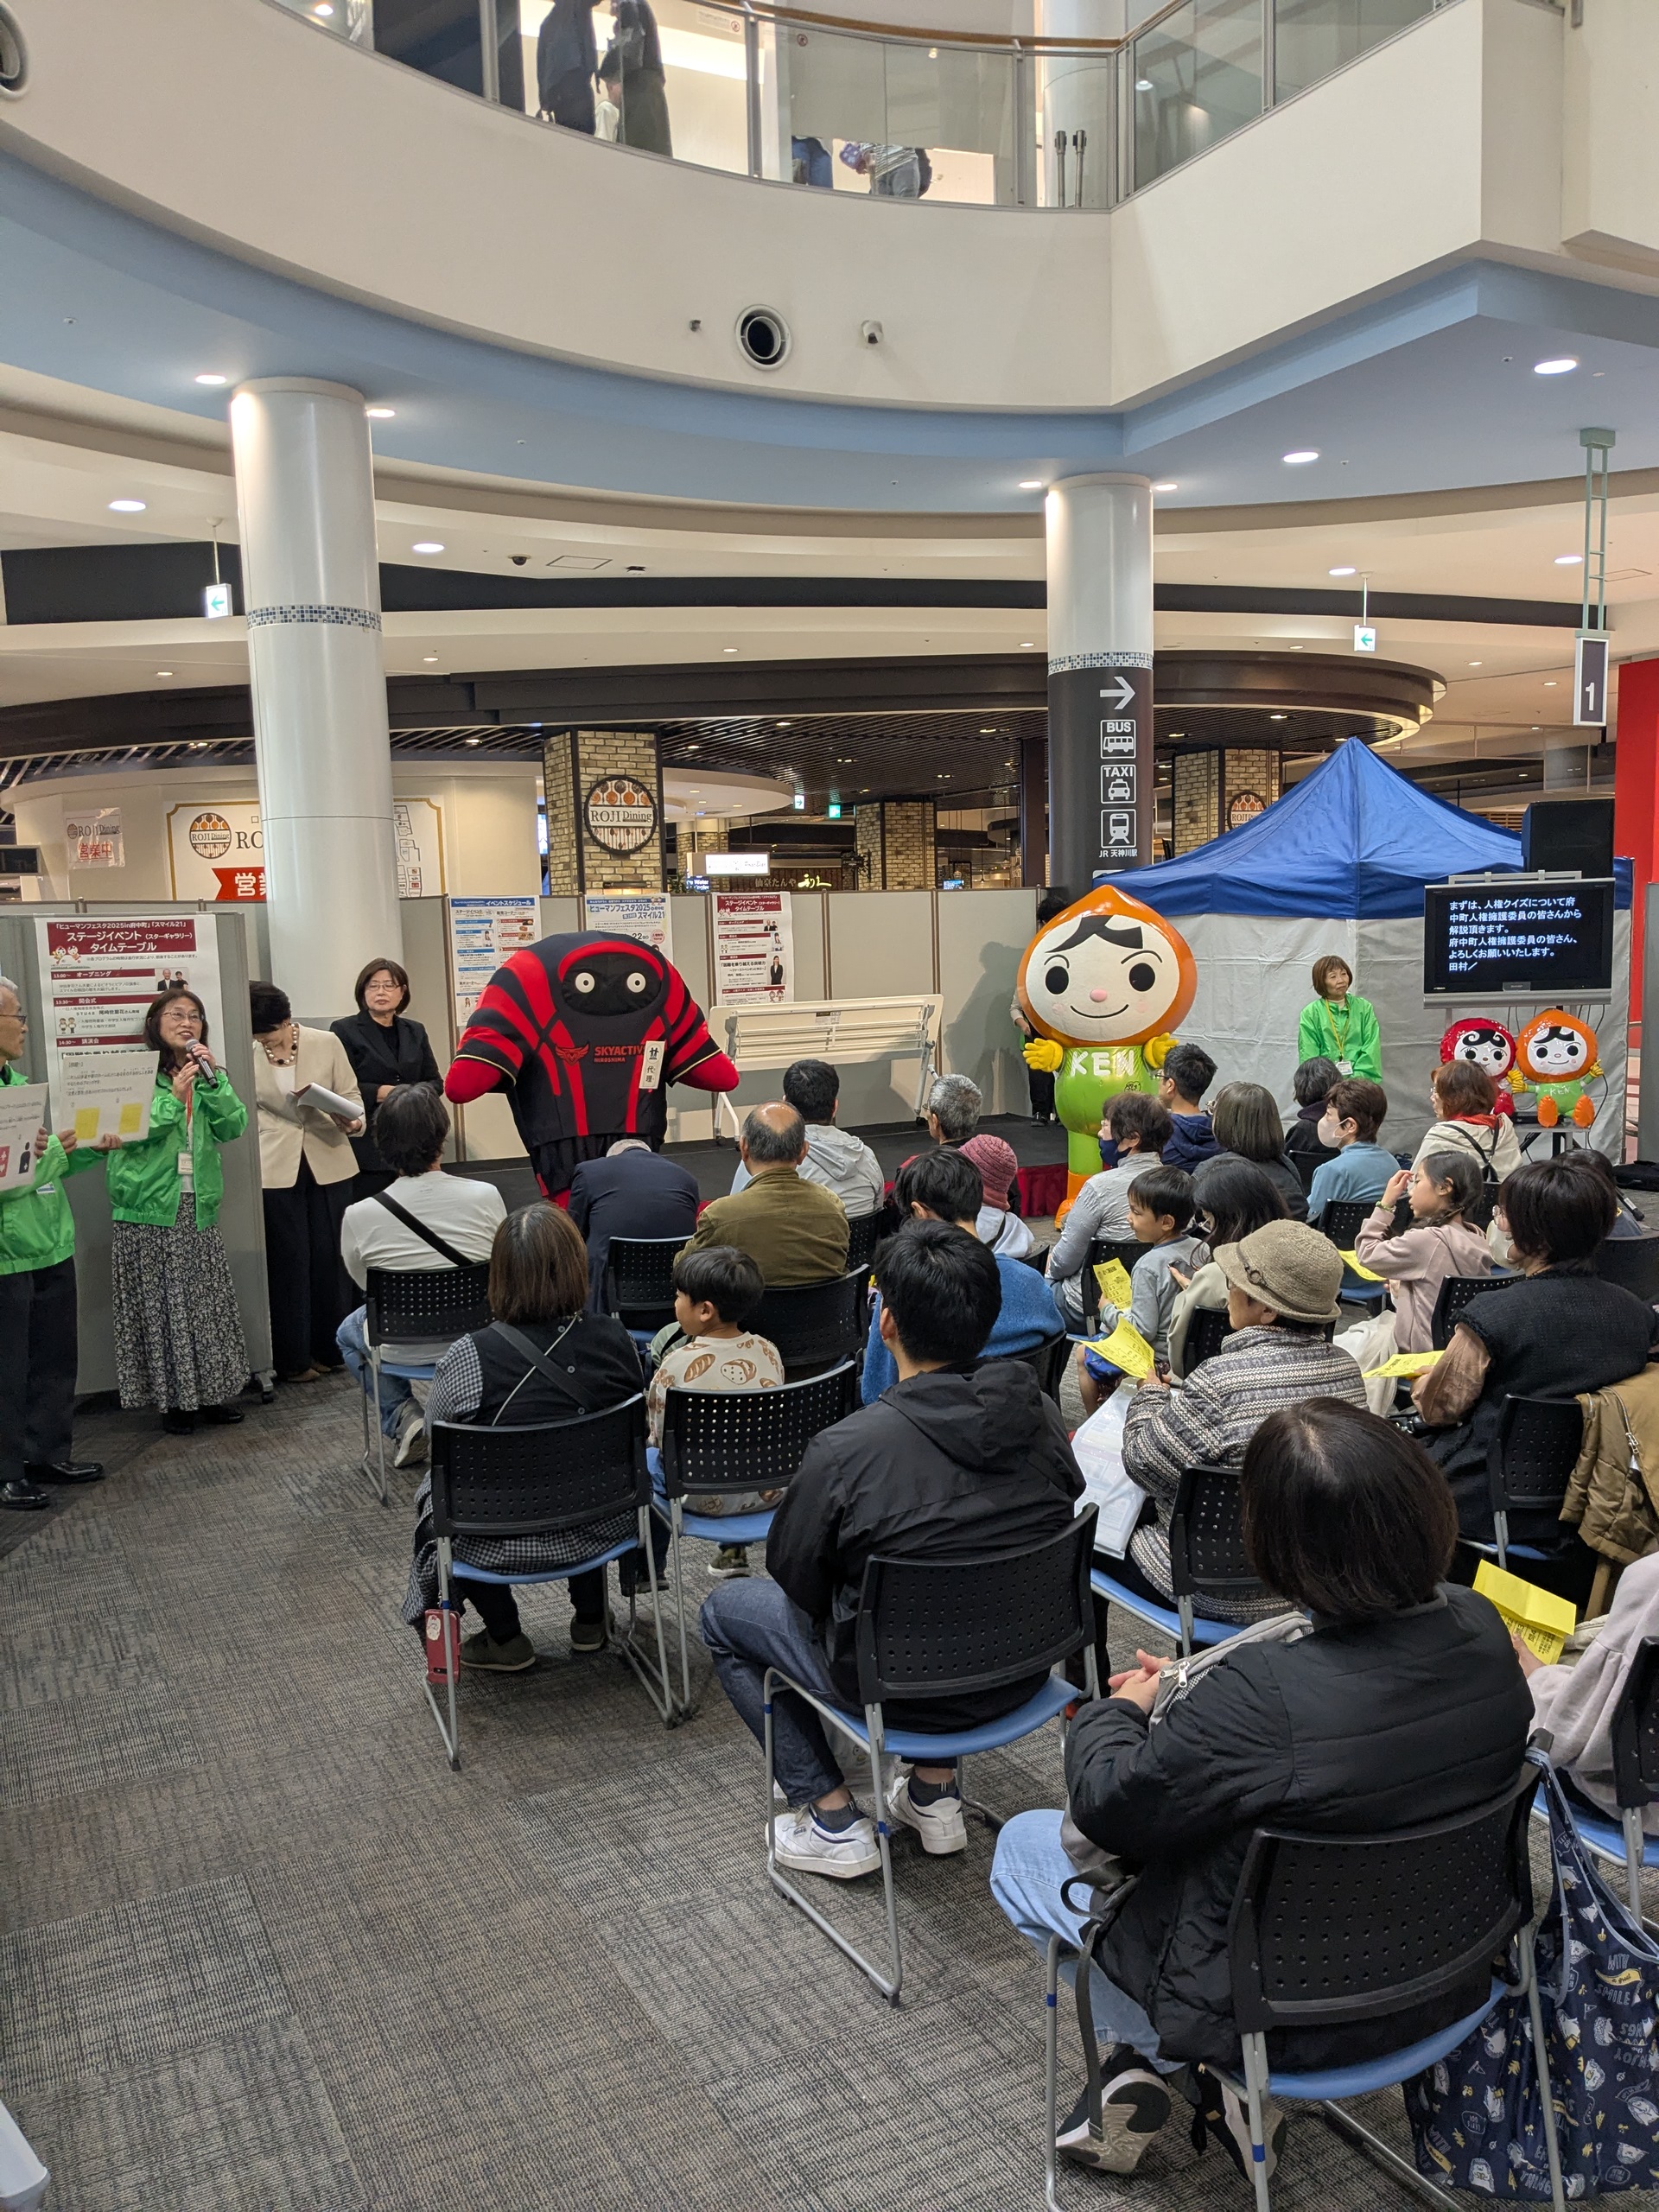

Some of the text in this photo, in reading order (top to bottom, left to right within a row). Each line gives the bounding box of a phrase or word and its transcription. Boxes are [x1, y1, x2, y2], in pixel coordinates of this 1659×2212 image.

[1585, 682, 1595, 711] 1
[1106, 721, 1131, 733] BUS
[1103, 766, 1134, 777] TAXI
[590, 810, 652, 823] ROJI Dining
[192, 832, 230, 842] ROJI Dining
[79, 842, 112, 860] 営業中
[1099, 849, 1138, 858] JR 天神川駅
[589, 904, 651, 912] ヒューマンフェスタ2025
[1449, 896, 1576, 911] まずは、人権クイズについて府
[637, 911, 665, 919] スマイル21
[1449, 908, 1582, 923] 中町人権擁護委員の皆さんから
[56, 921, 187, 930] 「ヒューマンフェスタ2025in府中町」「スマイル21」
[1448, 924, 1510, 935] 解説頂きます。
[67, 931, 142, 942] ステージイベント
[1448, 933, 1578, 948] 府中町人権擁護委員の皆さん、
[90, 942, 157, 953] タイムテーブル
[1448, 947, 1554, 959] よろしくお願いいたします。
[594, 1045, 645, 1056] SKYACTIV
[1071, 1050, 1135, 1077] KEN
[1549, 1086, 1571, 1096] KEN
[1607, 1953, 1630, 1971] WITH
[1595, 1984, 1631, 2005] SMILE
[1613, 2047, 1650, 2069] NJOY
